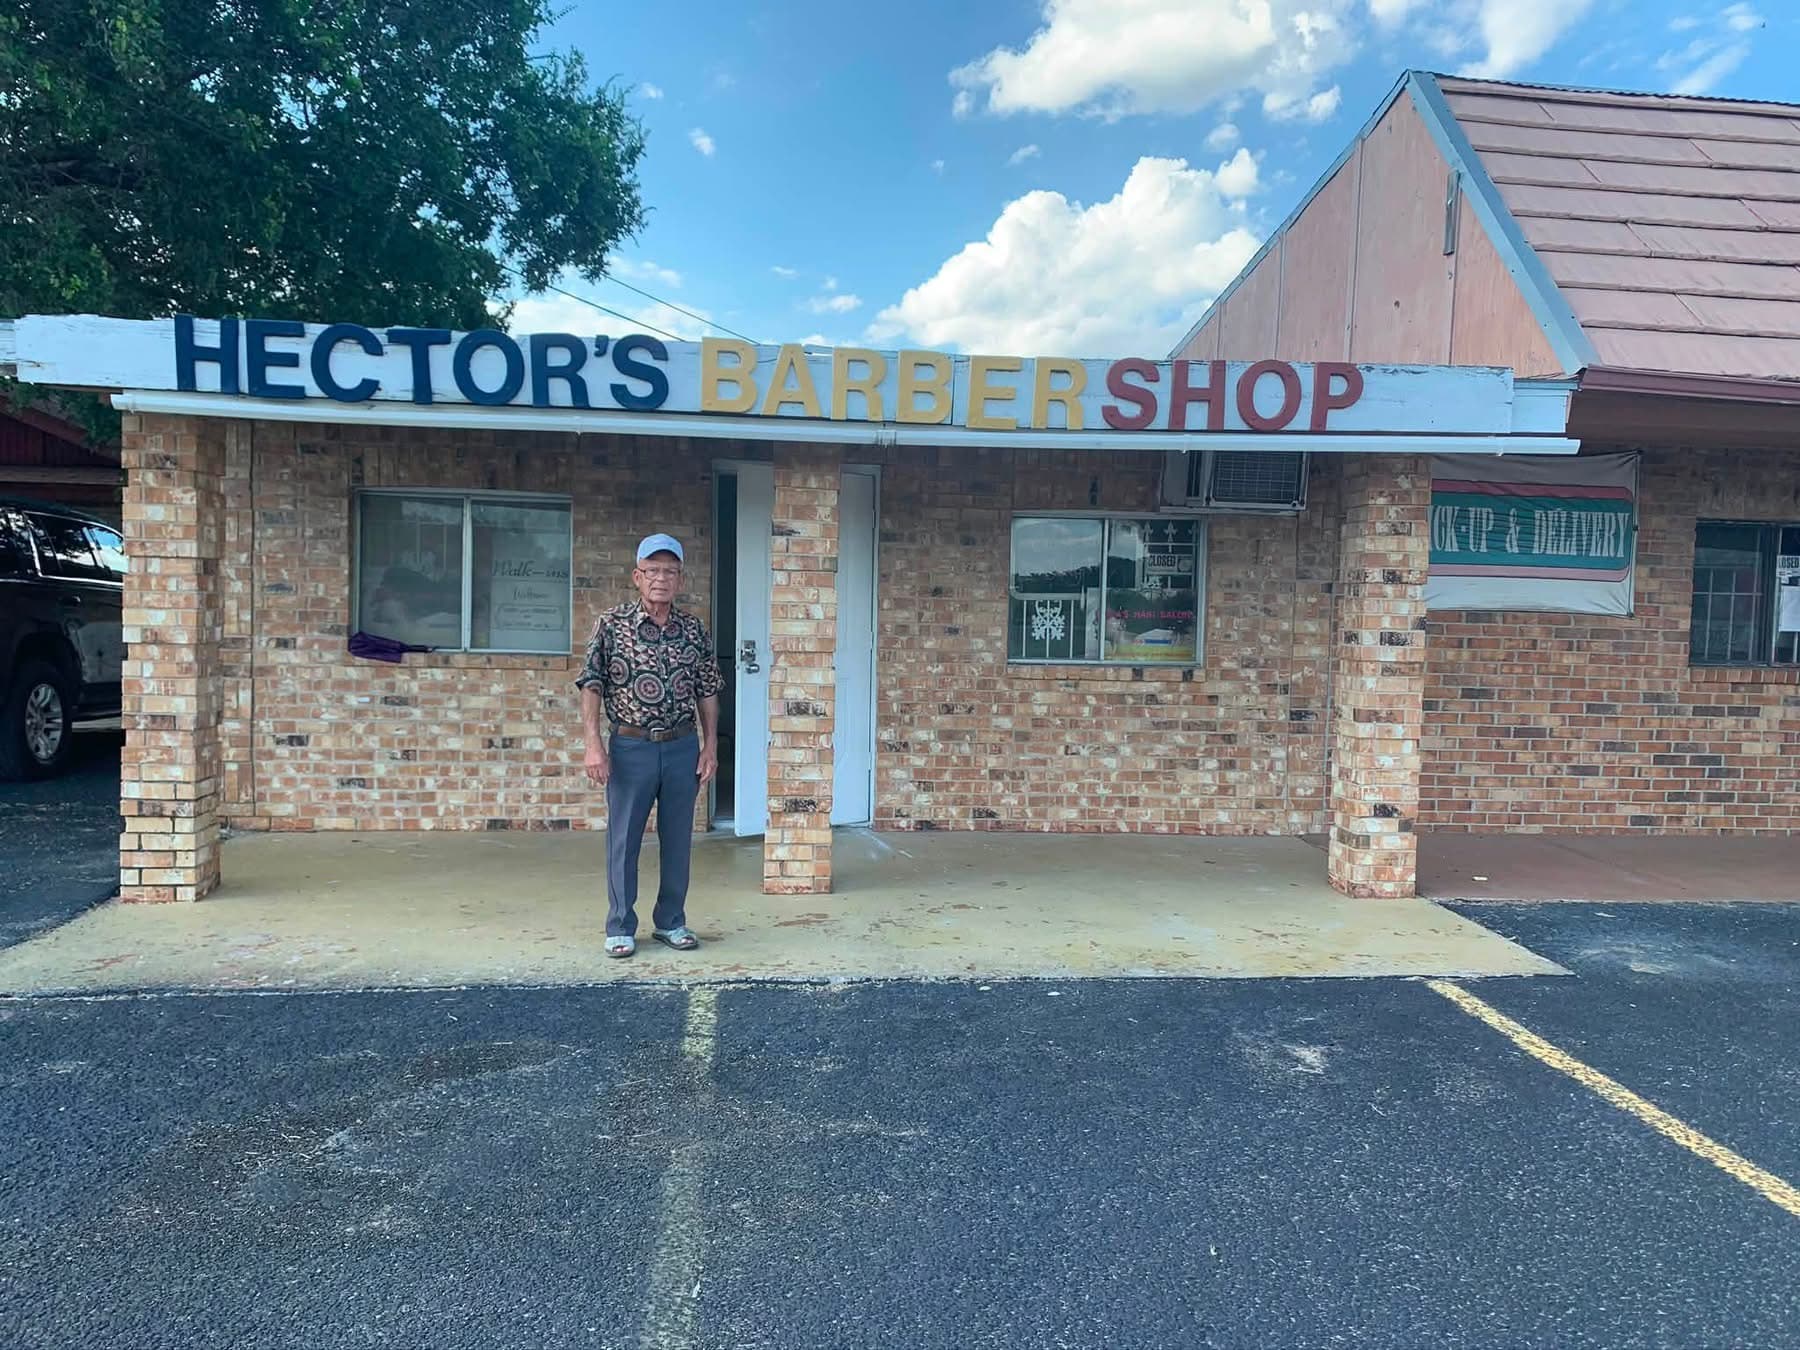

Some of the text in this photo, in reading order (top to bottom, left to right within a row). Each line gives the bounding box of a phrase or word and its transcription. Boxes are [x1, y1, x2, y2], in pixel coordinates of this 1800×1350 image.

[174, 313, 1364, 433] HECTOR'S BARBER SHOP
[1505, 508, 1521, 553] &
[1532, 508, 1630, 558] DELIVERY
